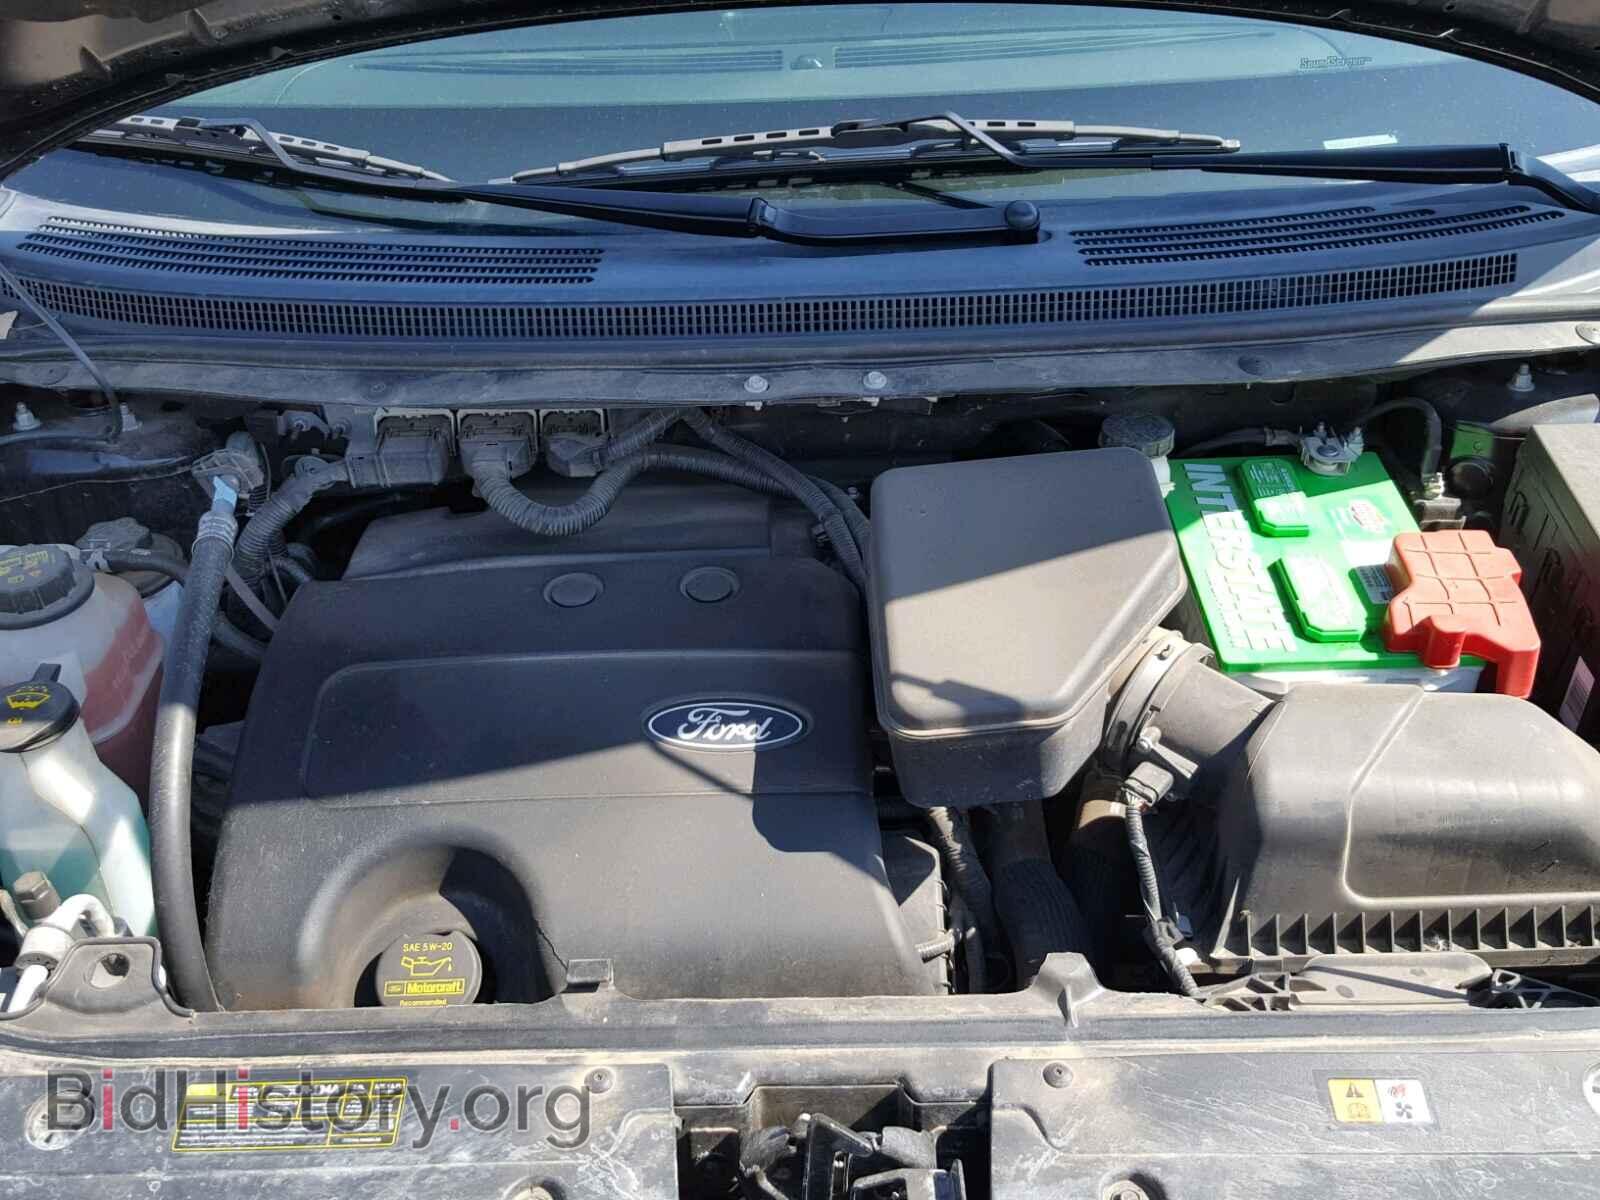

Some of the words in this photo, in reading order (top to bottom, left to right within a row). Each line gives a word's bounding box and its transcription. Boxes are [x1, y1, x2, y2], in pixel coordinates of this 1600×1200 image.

[677, 707, 773, 740] Ford
[403, 943, 420, 952] SAE
[407, 981, 461, 994] Motorcraft
